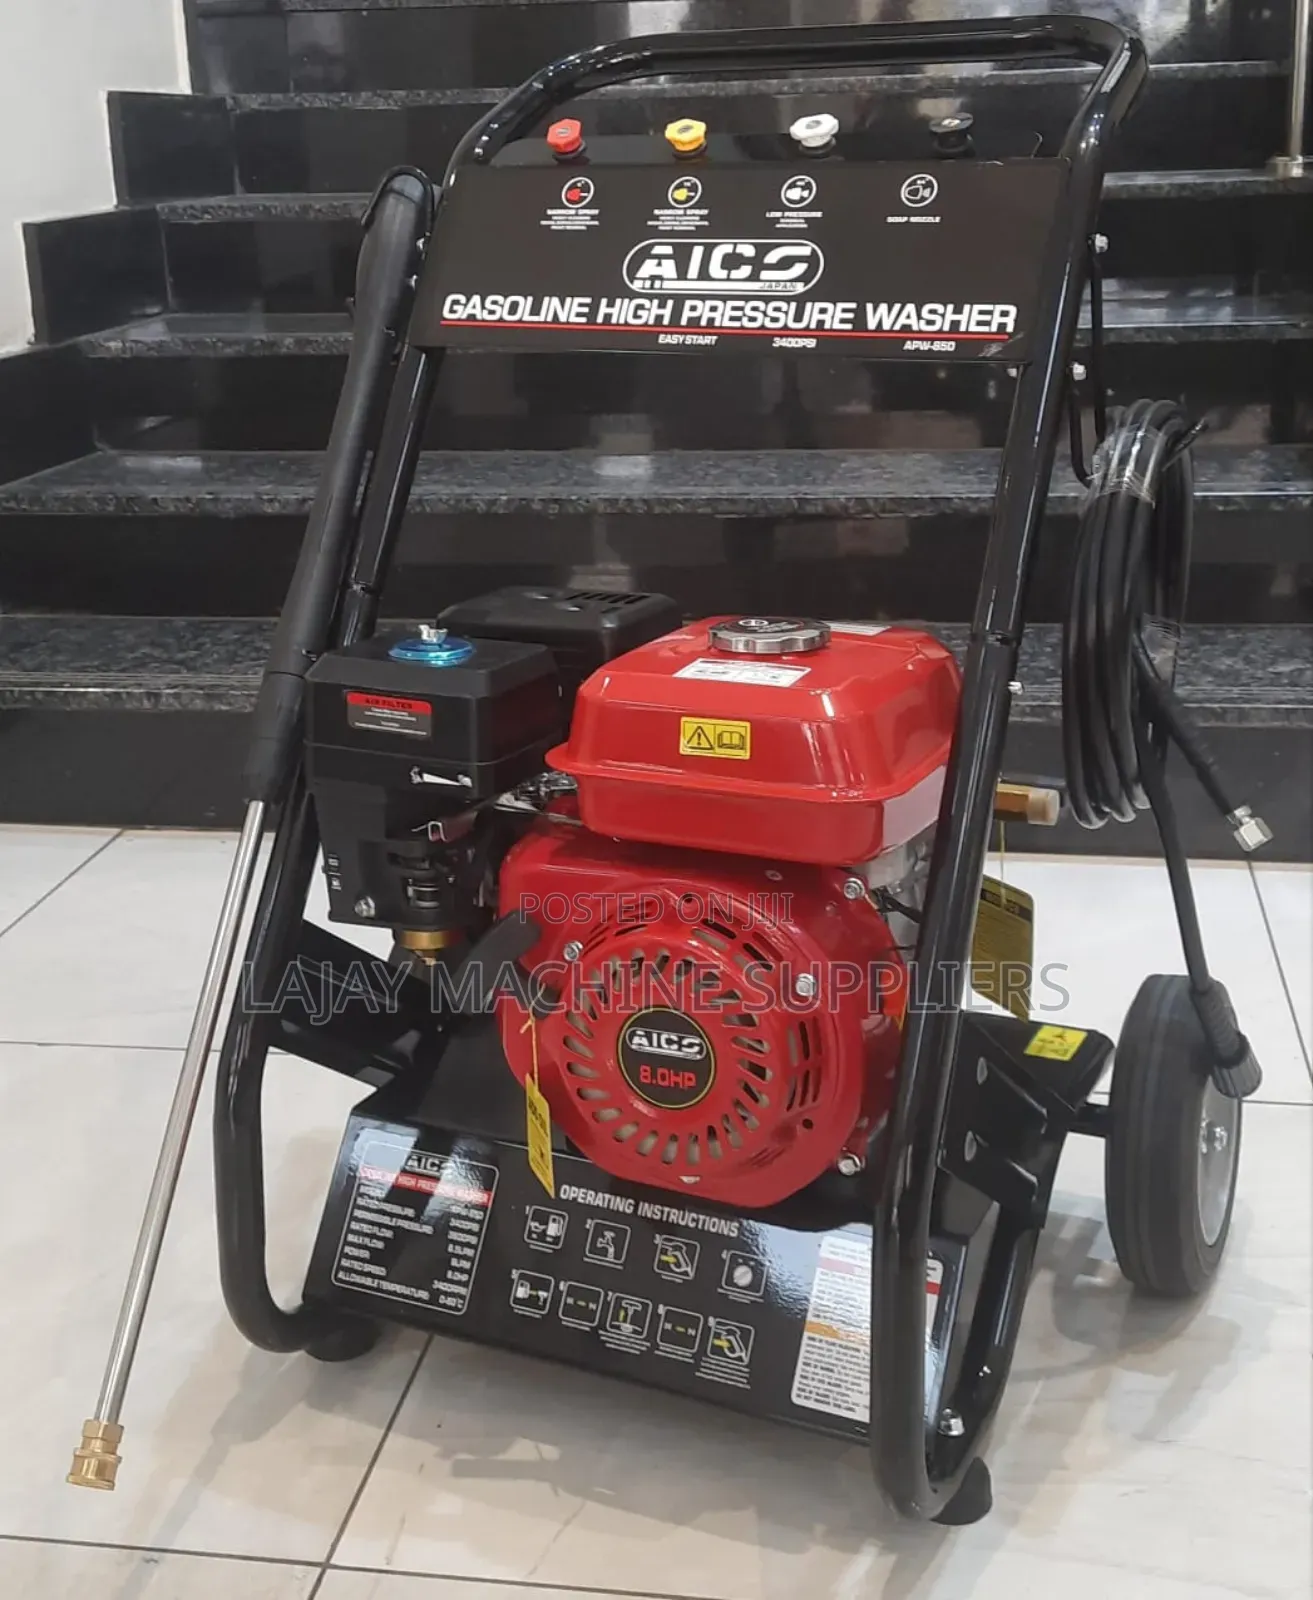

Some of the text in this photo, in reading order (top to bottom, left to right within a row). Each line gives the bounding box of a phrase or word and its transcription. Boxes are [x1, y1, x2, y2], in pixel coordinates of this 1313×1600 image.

[635, 243, 812, 281] AICS
[759, 281, 798, 290] JAPAN
[442, 292, 1018, 333] GASOLINE HIGH PRESSURE WASHER
[658, 334, 718, 346] EASY START
[631, 1030, 702, 1054] AICS
[640, 1065, 697, 1089] 8.0HP
[559, 1184, 741, 1238] OPERATING INSTRUCTIONS
